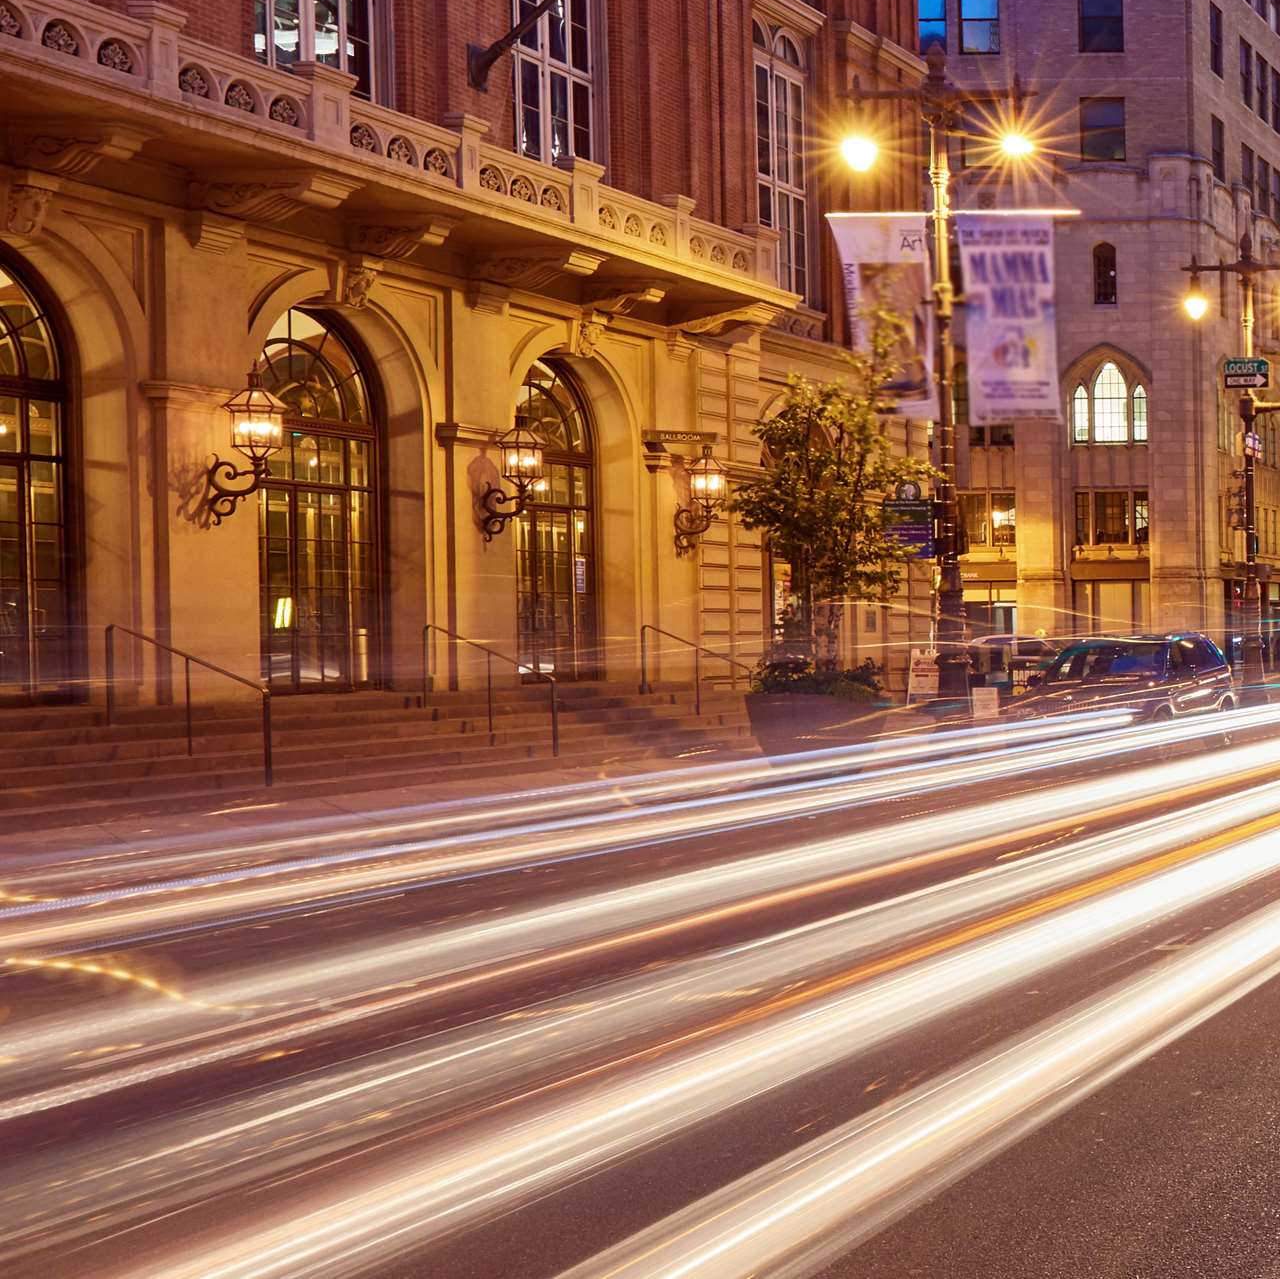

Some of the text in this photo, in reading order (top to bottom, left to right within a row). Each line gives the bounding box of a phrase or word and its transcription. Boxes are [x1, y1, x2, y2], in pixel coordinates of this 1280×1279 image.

[901, 236, 923, 251] Art
[1226, 363, 1258, 373] LOCUST
[660, 433, 701, 441] BALLROOM
